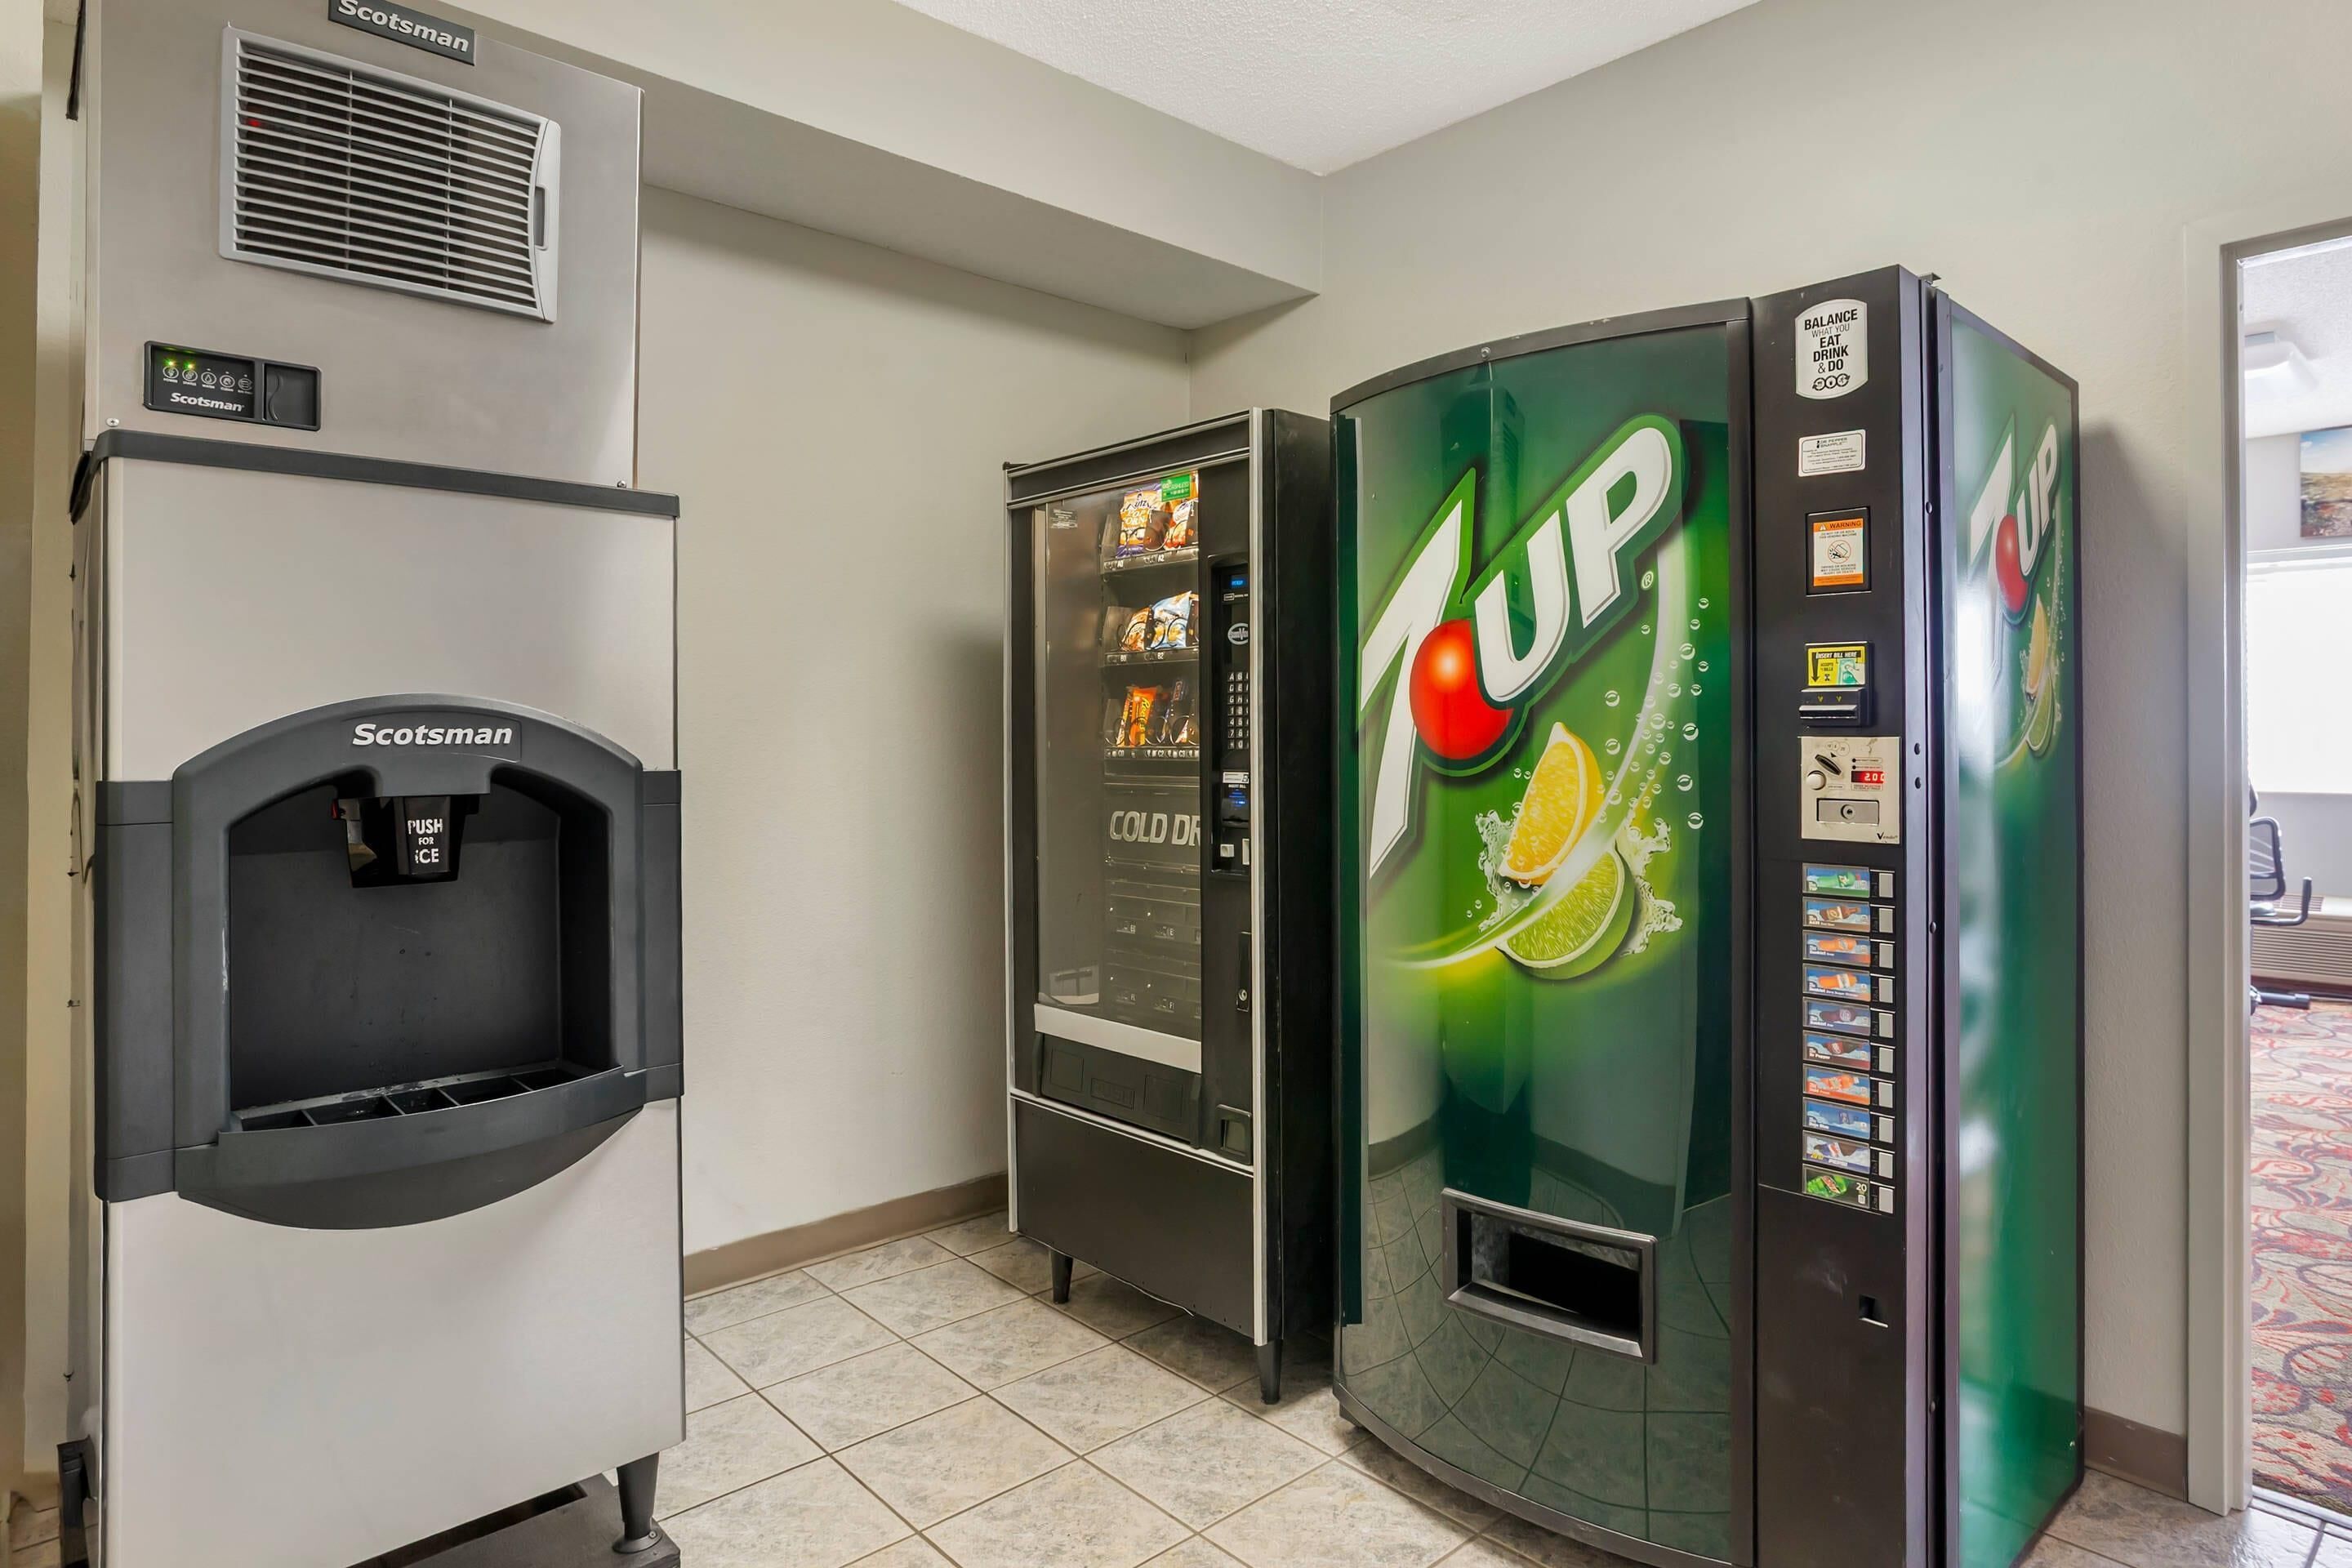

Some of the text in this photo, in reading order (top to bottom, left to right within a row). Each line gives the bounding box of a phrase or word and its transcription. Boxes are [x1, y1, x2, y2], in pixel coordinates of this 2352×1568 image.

[338, 0, 470, 52] Scotsman
[1804, 308, 1858, 331] BALANCE
[1811, 323, 1851, 338] WHAT YOU
[1813, 345, 1849, 362] DRINK
[1817, 359, 1844, 374] & DO
[170, 392, 244, 412] Scotsman
[1829, 519, 1862, 529] WARNING
[1229, 672, 1234, 680] A
[1229, 695, 1234, 703] G
[1229, 718, 1235, 726] 4
[352, 723, 513, 746] Scotsman
[407, 818, 443, 835] PUSH
[1109, 810, 1169, 844] COLD
[418, 836, 434, 845] FOR
[414, 848, 439, 864] ICE
[1855, 1182, 1868, 1192] 20
